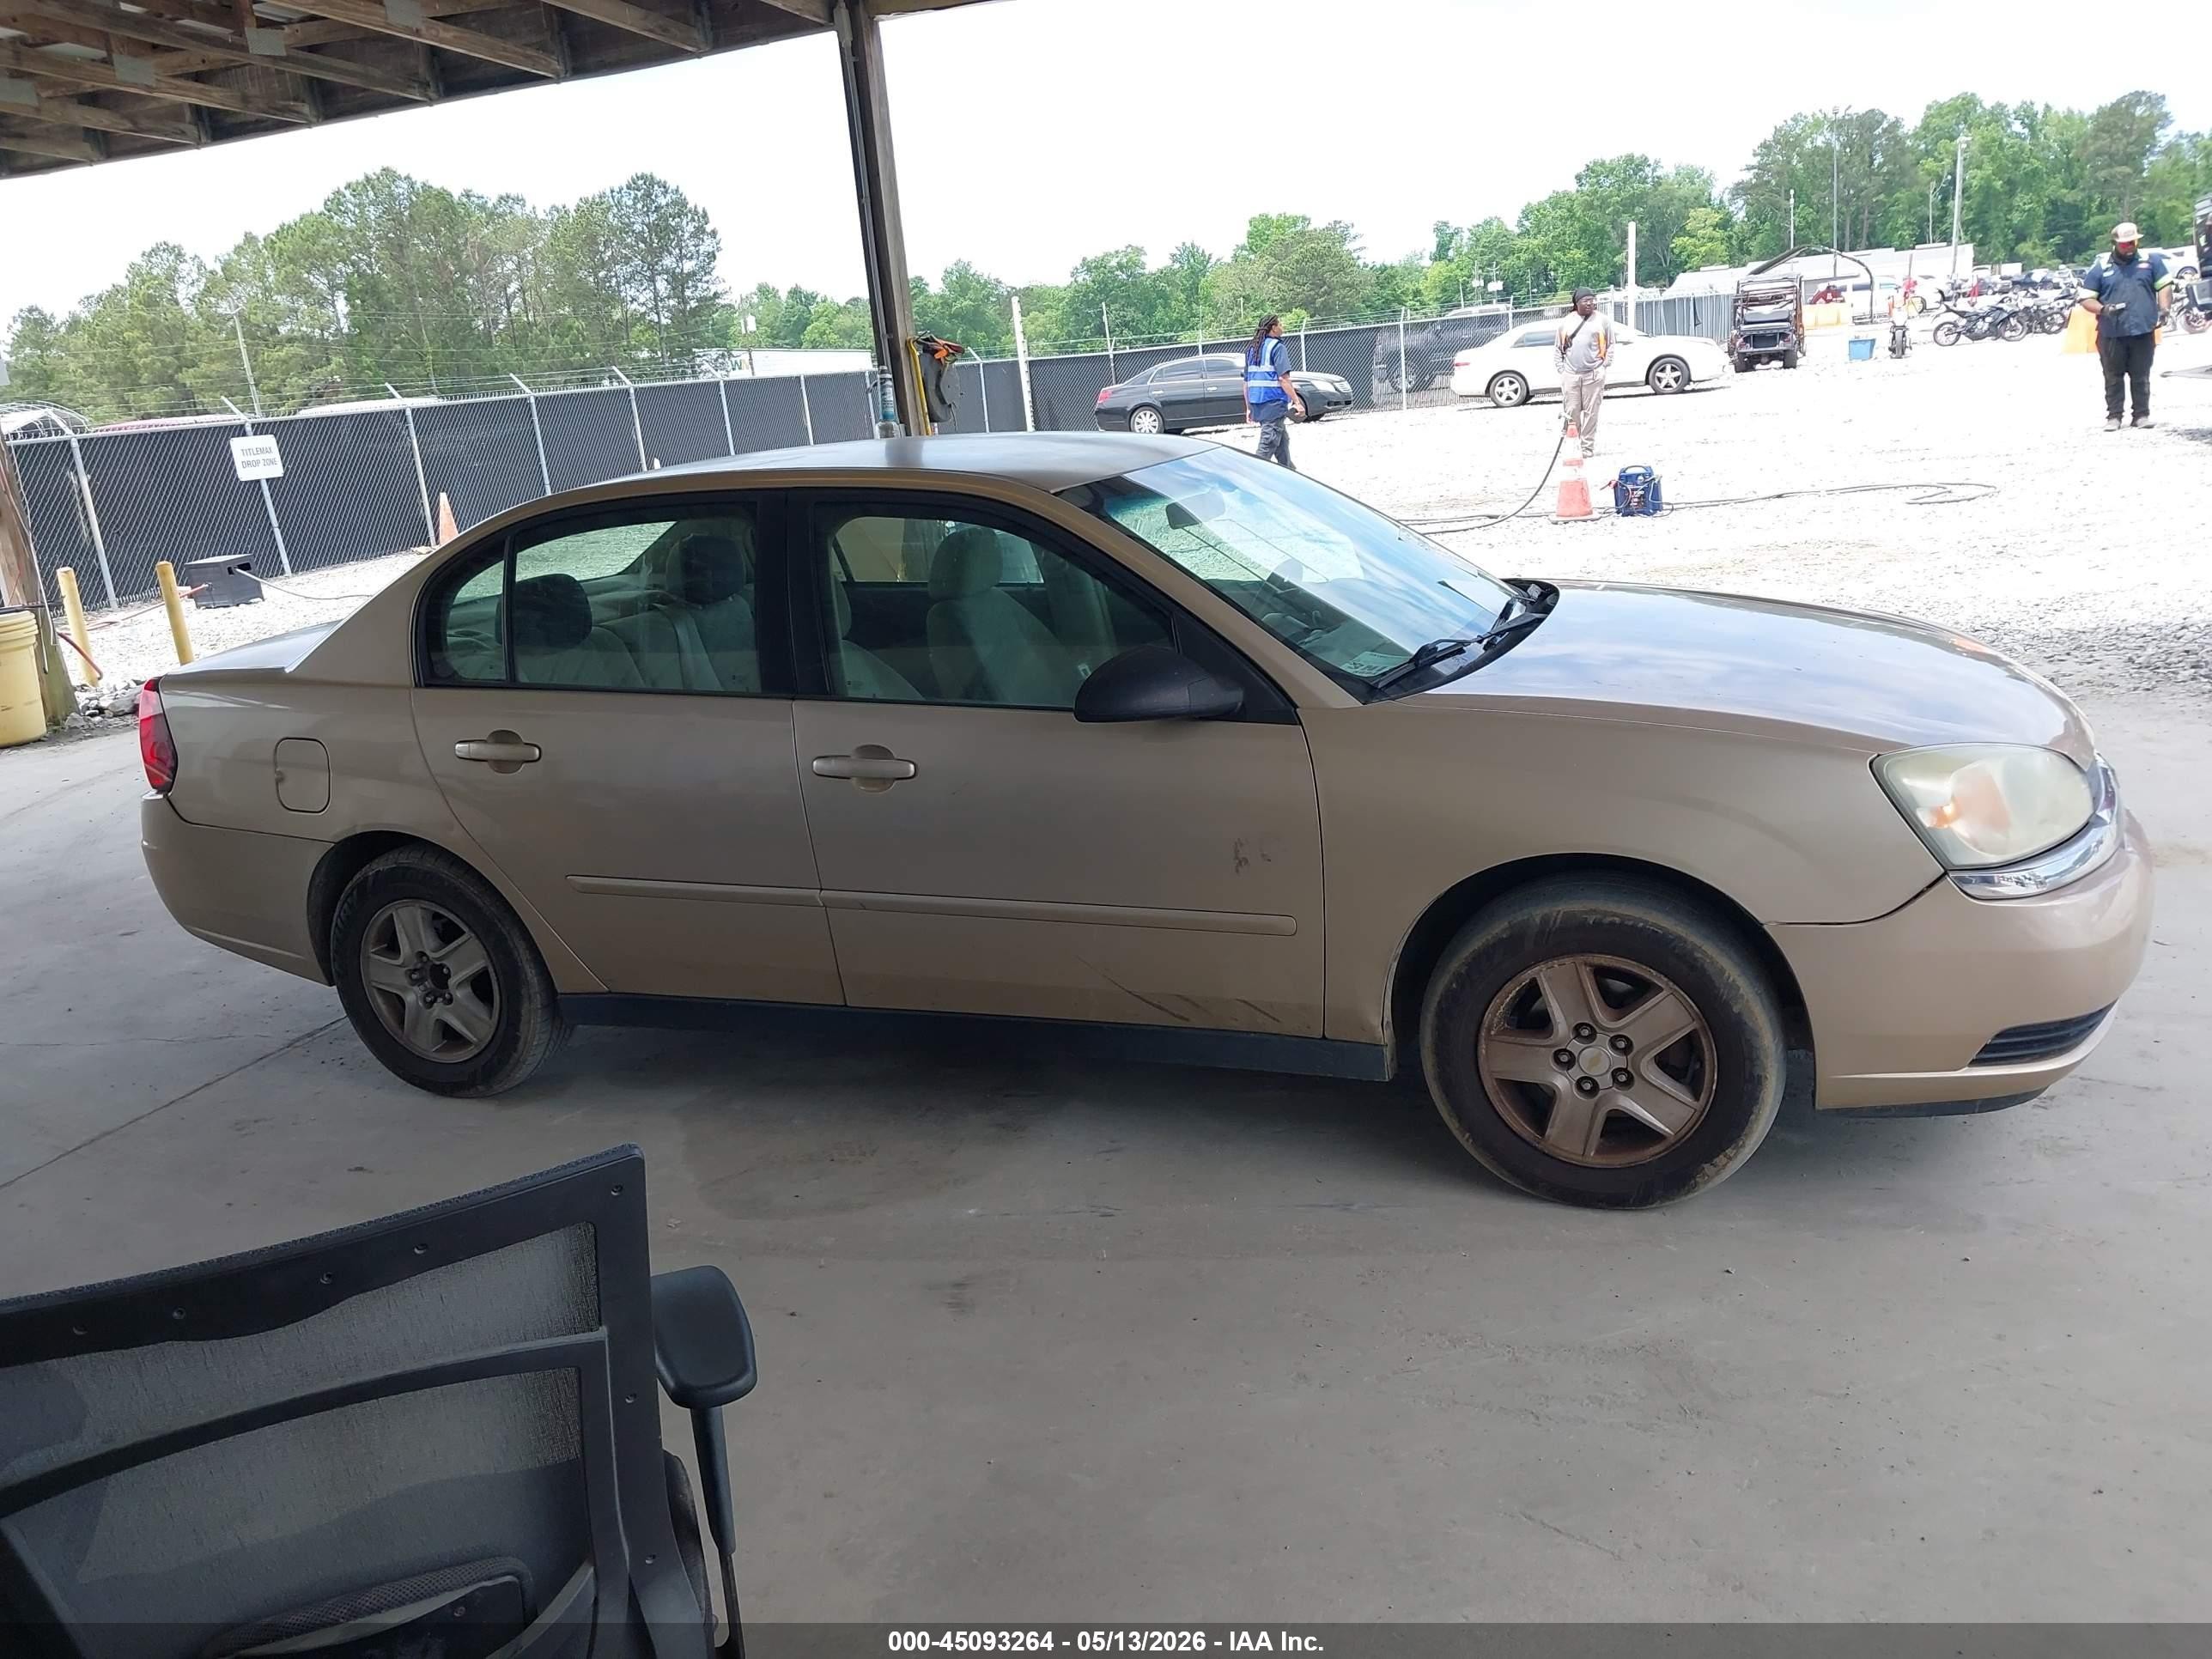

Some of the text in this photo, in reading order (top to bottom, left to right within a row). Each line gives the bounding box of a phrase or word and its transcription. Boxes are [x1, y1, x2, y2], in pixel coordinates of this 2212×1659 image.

[240, 447, 273, 457] TITLEMAX
[241, 458, 278, 469] DROP ZONE
